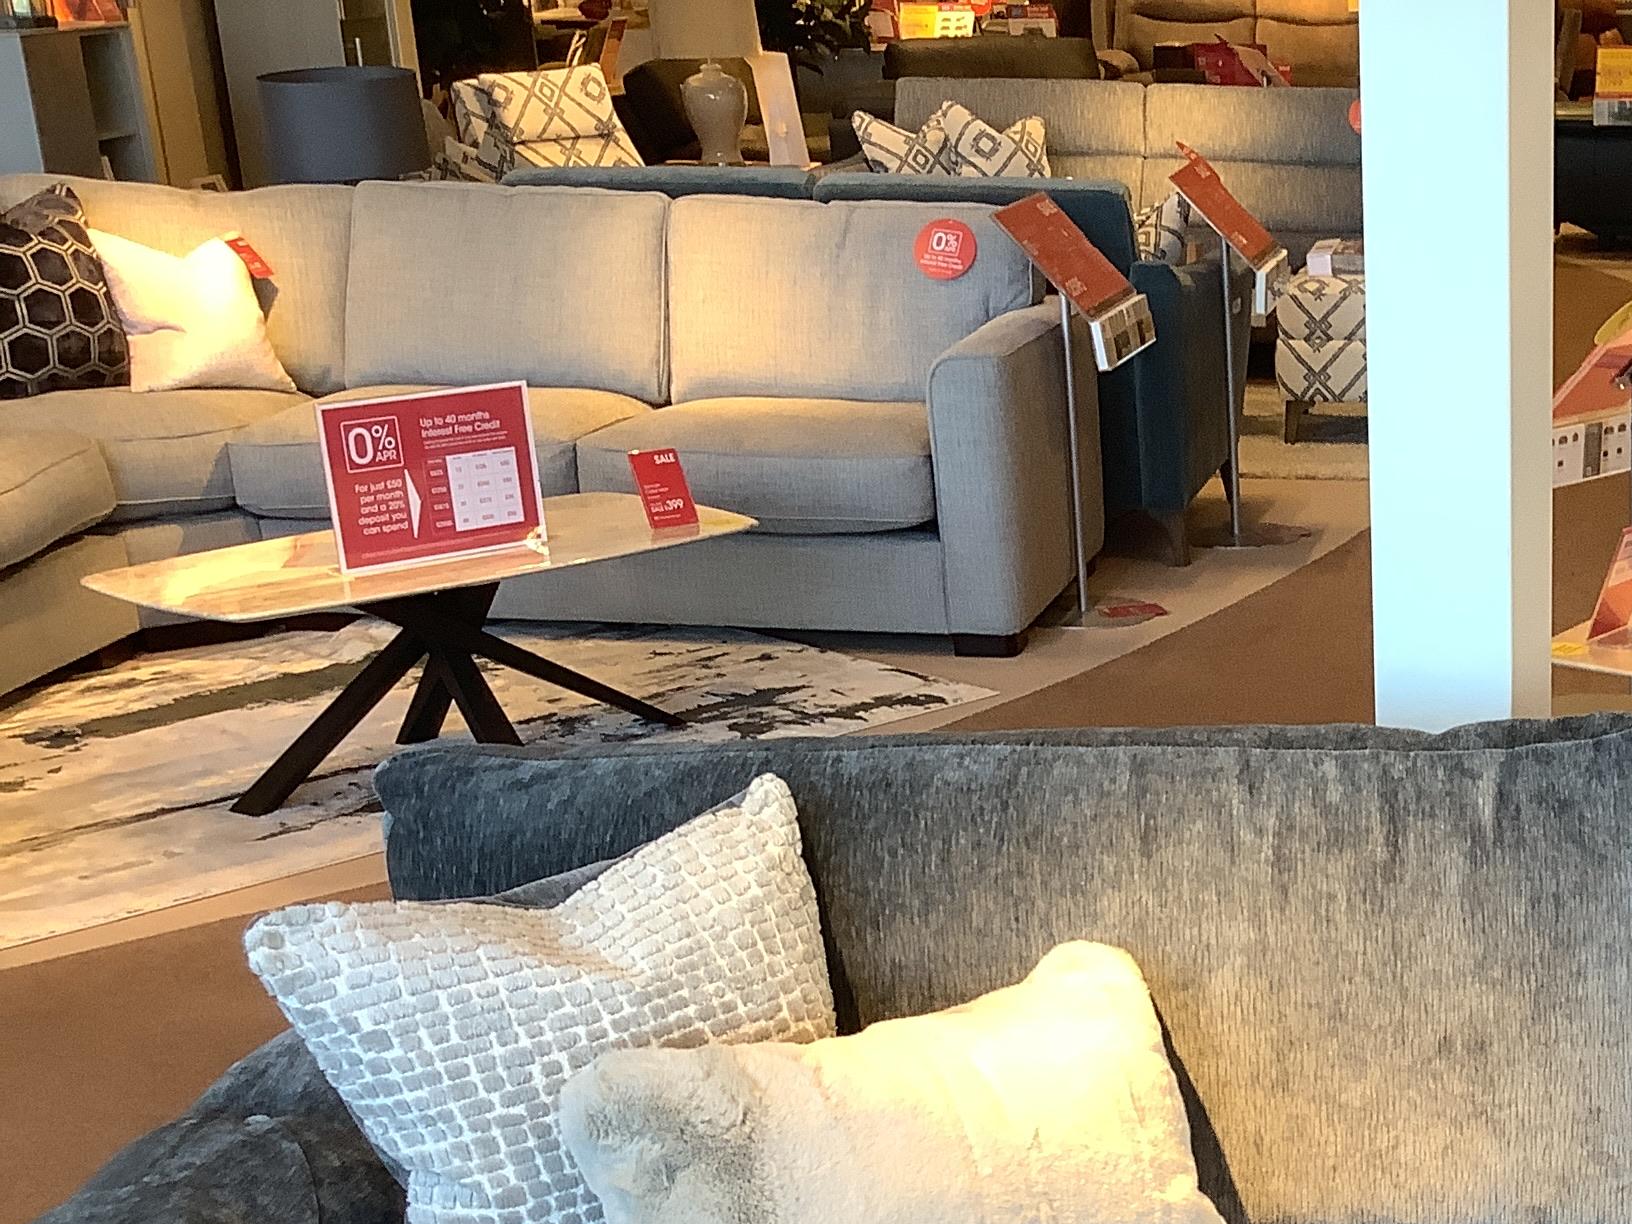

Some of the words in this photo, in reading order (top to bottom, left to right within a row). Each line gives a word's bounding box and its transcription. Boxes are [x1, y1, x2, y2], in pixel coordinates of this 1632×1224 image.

[932, 232, 958, 251] 0%
[420, 418, 433, 428] Up
[434, 416, 443, 425] to
[445, 414, 456, 424] 40
[457, 411, 490, 422] months
[421, 426, 452, 438] Interest
[454, 424, 473, 434] Free
[474, 420, 500, 431] Credit
[348, 424, 396, 465] 0%
[375, 450, 397, 462] APR
[653, 453, 676, 465] SALE
[354, 483, 368, 493] For
[369, 481, 385, 493] just
[360, 494, 374, 504] per
[376, 490, 403, 501] month
[360, 504, 378, 514] and
[379, 504, 386, 512] a
[358, 513, 390, 525] deposit
[391, 512, 407, 523] you
[363, 526, 380, 535] can
[382, 521, 408, 534] spend
